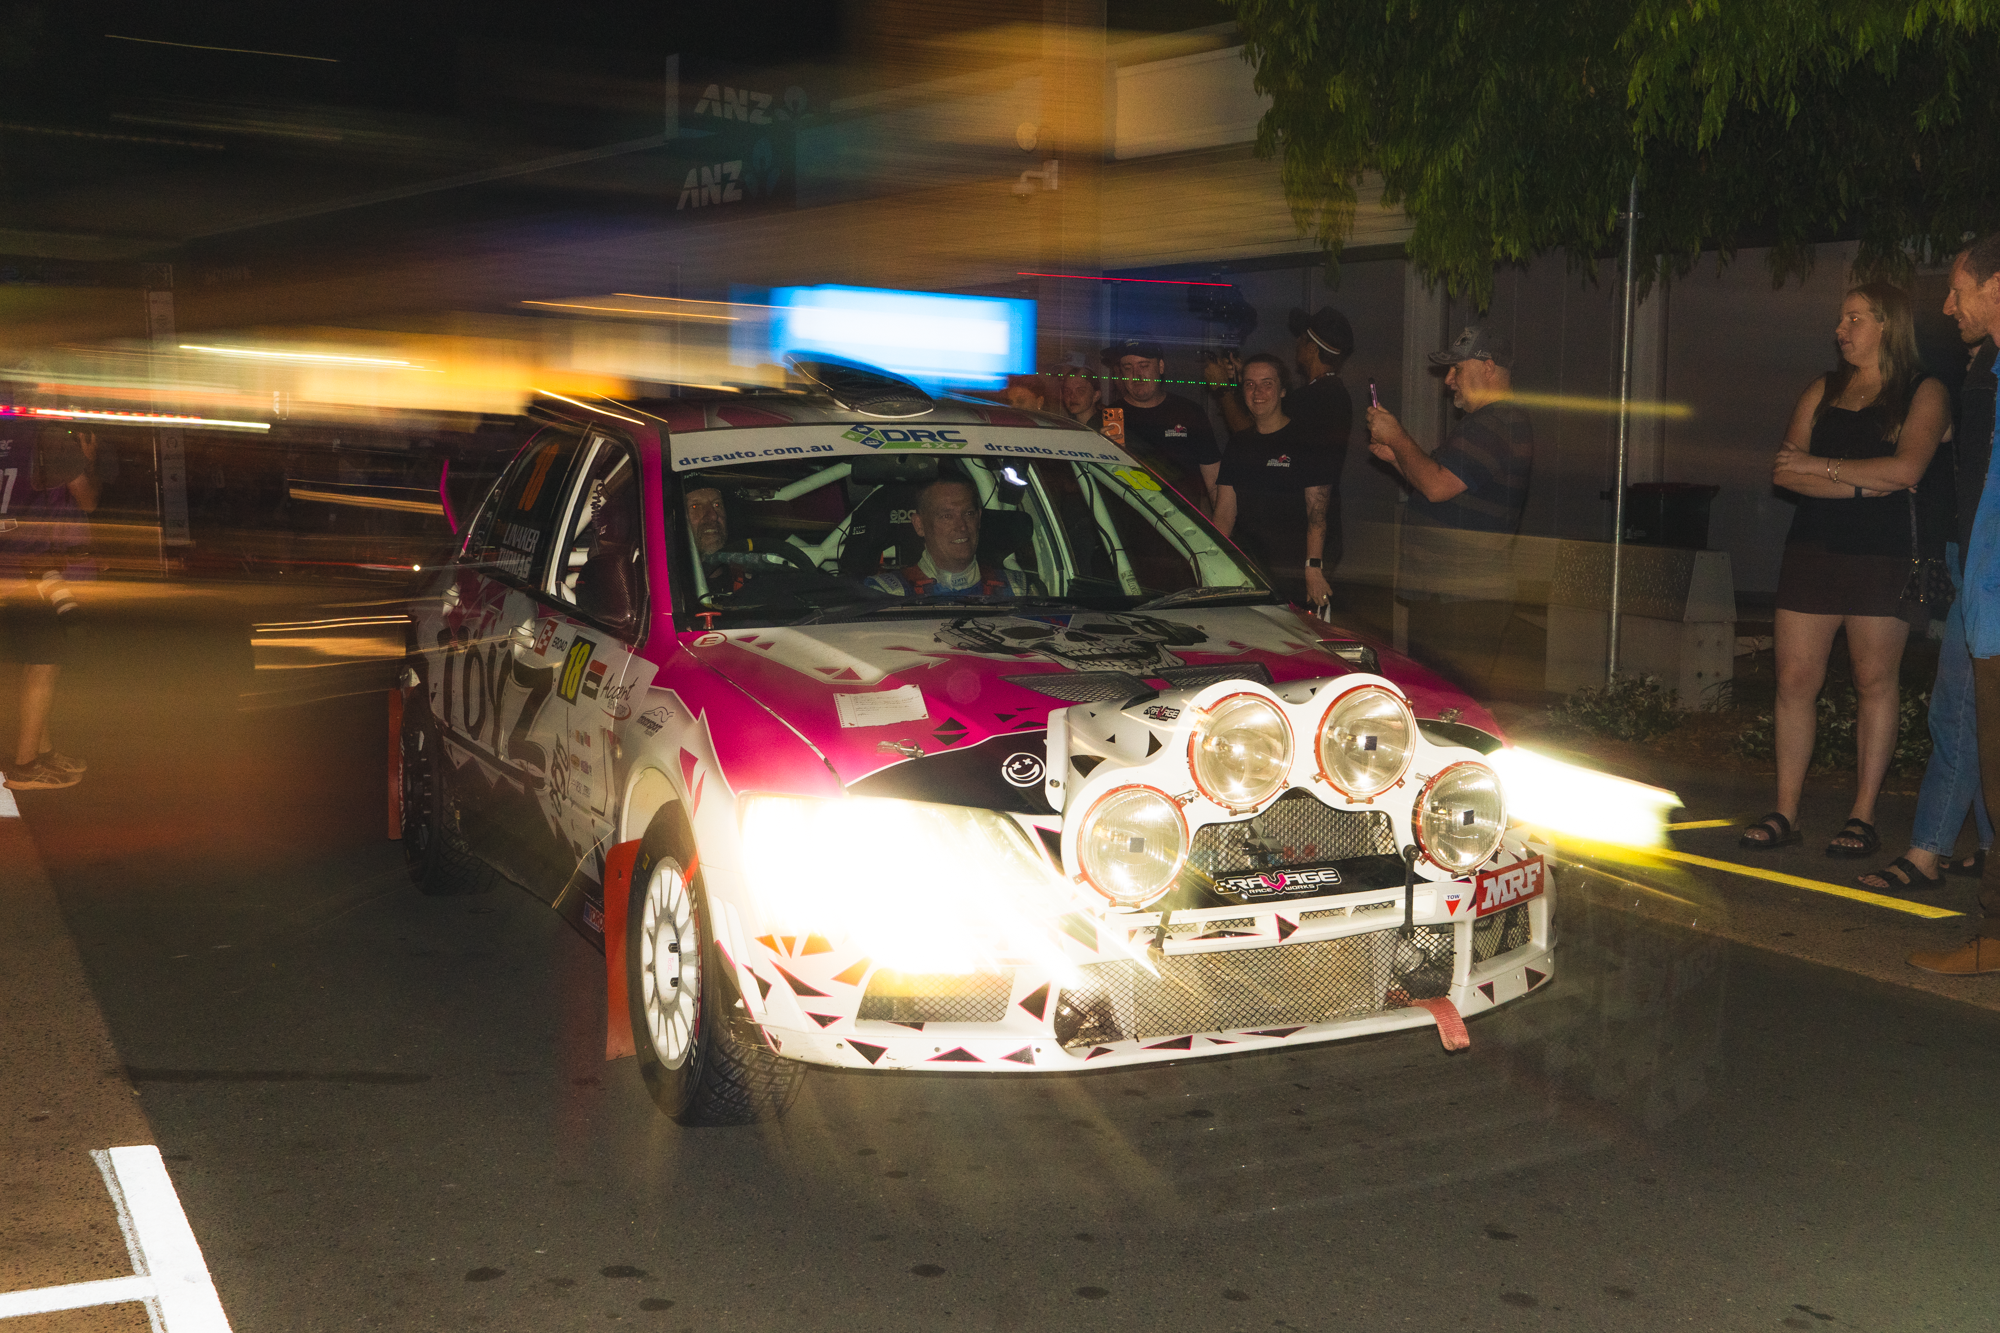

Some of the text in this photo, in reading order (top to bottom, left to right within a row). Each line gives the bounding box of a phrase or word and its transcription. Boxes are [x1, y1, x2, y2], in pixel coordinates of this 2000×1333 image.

[694, 84, 773, 125] ANZ
[676, 159, 743, 211] ANZ
[878, 429, 967, 443] DRC
[678, 443, 834, 466] drcauto.com.au
[984, 443, 1121, 462] drcauto.com.au
[1114, 470, 1162, 491] 18
[561, 641, 591, 700] 18
[599, 672, 640, 701] Accent
[1149, 706, 1180, 719] RAVAGE
[1227, 870, 1339, 891] RAVAGE
[1284, 883, 1316, 891] WORKS
[1481, 862, 1541, 911] MRF
